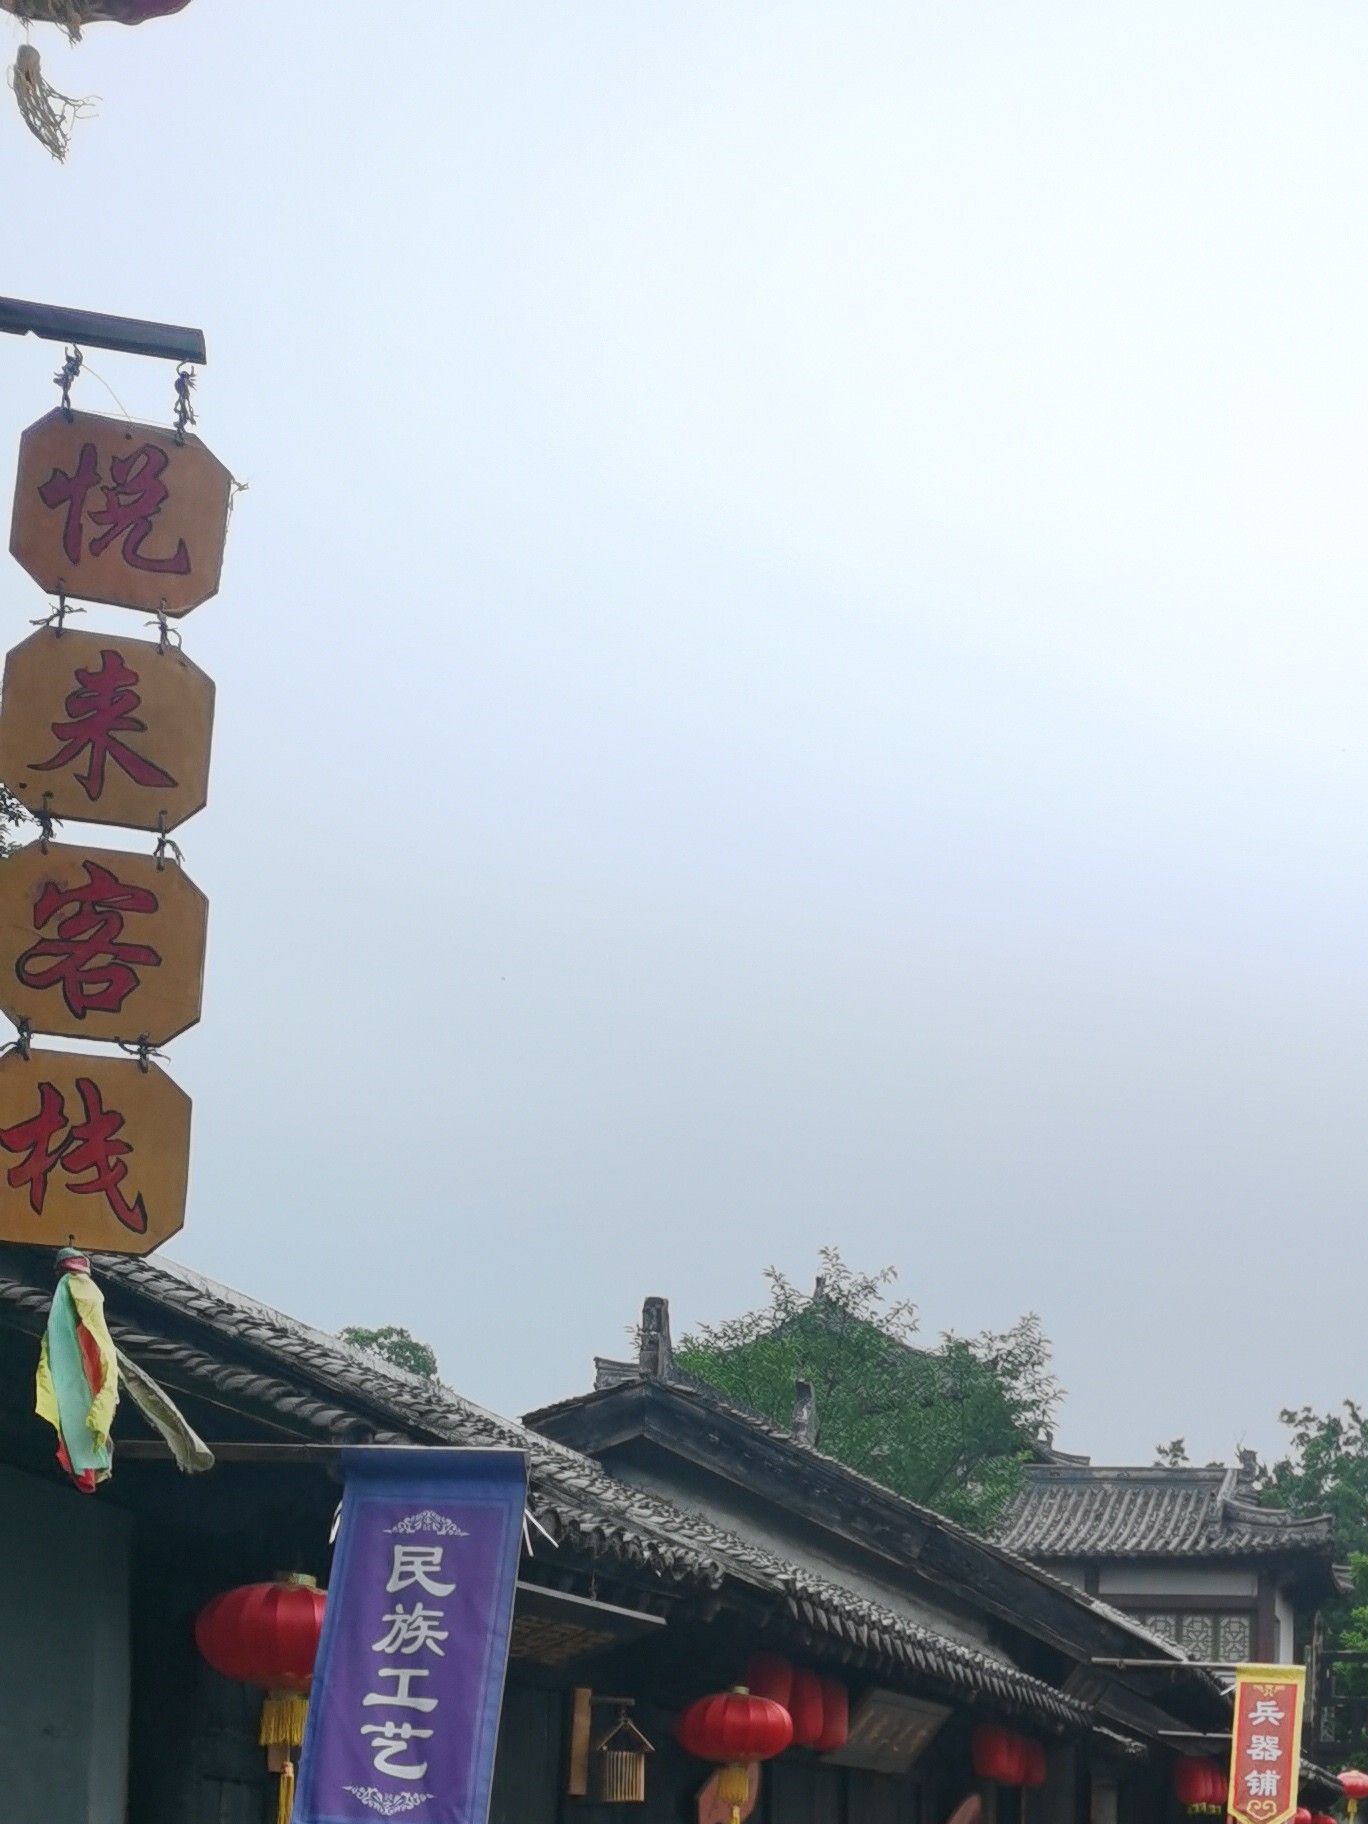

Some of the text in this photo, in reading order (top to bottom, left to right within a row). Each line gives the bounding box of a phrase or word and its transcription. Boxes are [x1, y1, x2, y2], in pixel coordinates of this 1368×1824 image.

[1, 441, 192, 1233] 悦来客栈
[361, 1544, 457, 1781] 民族工艺
[1244, 1700, 1286, 1797] 兵器铺
